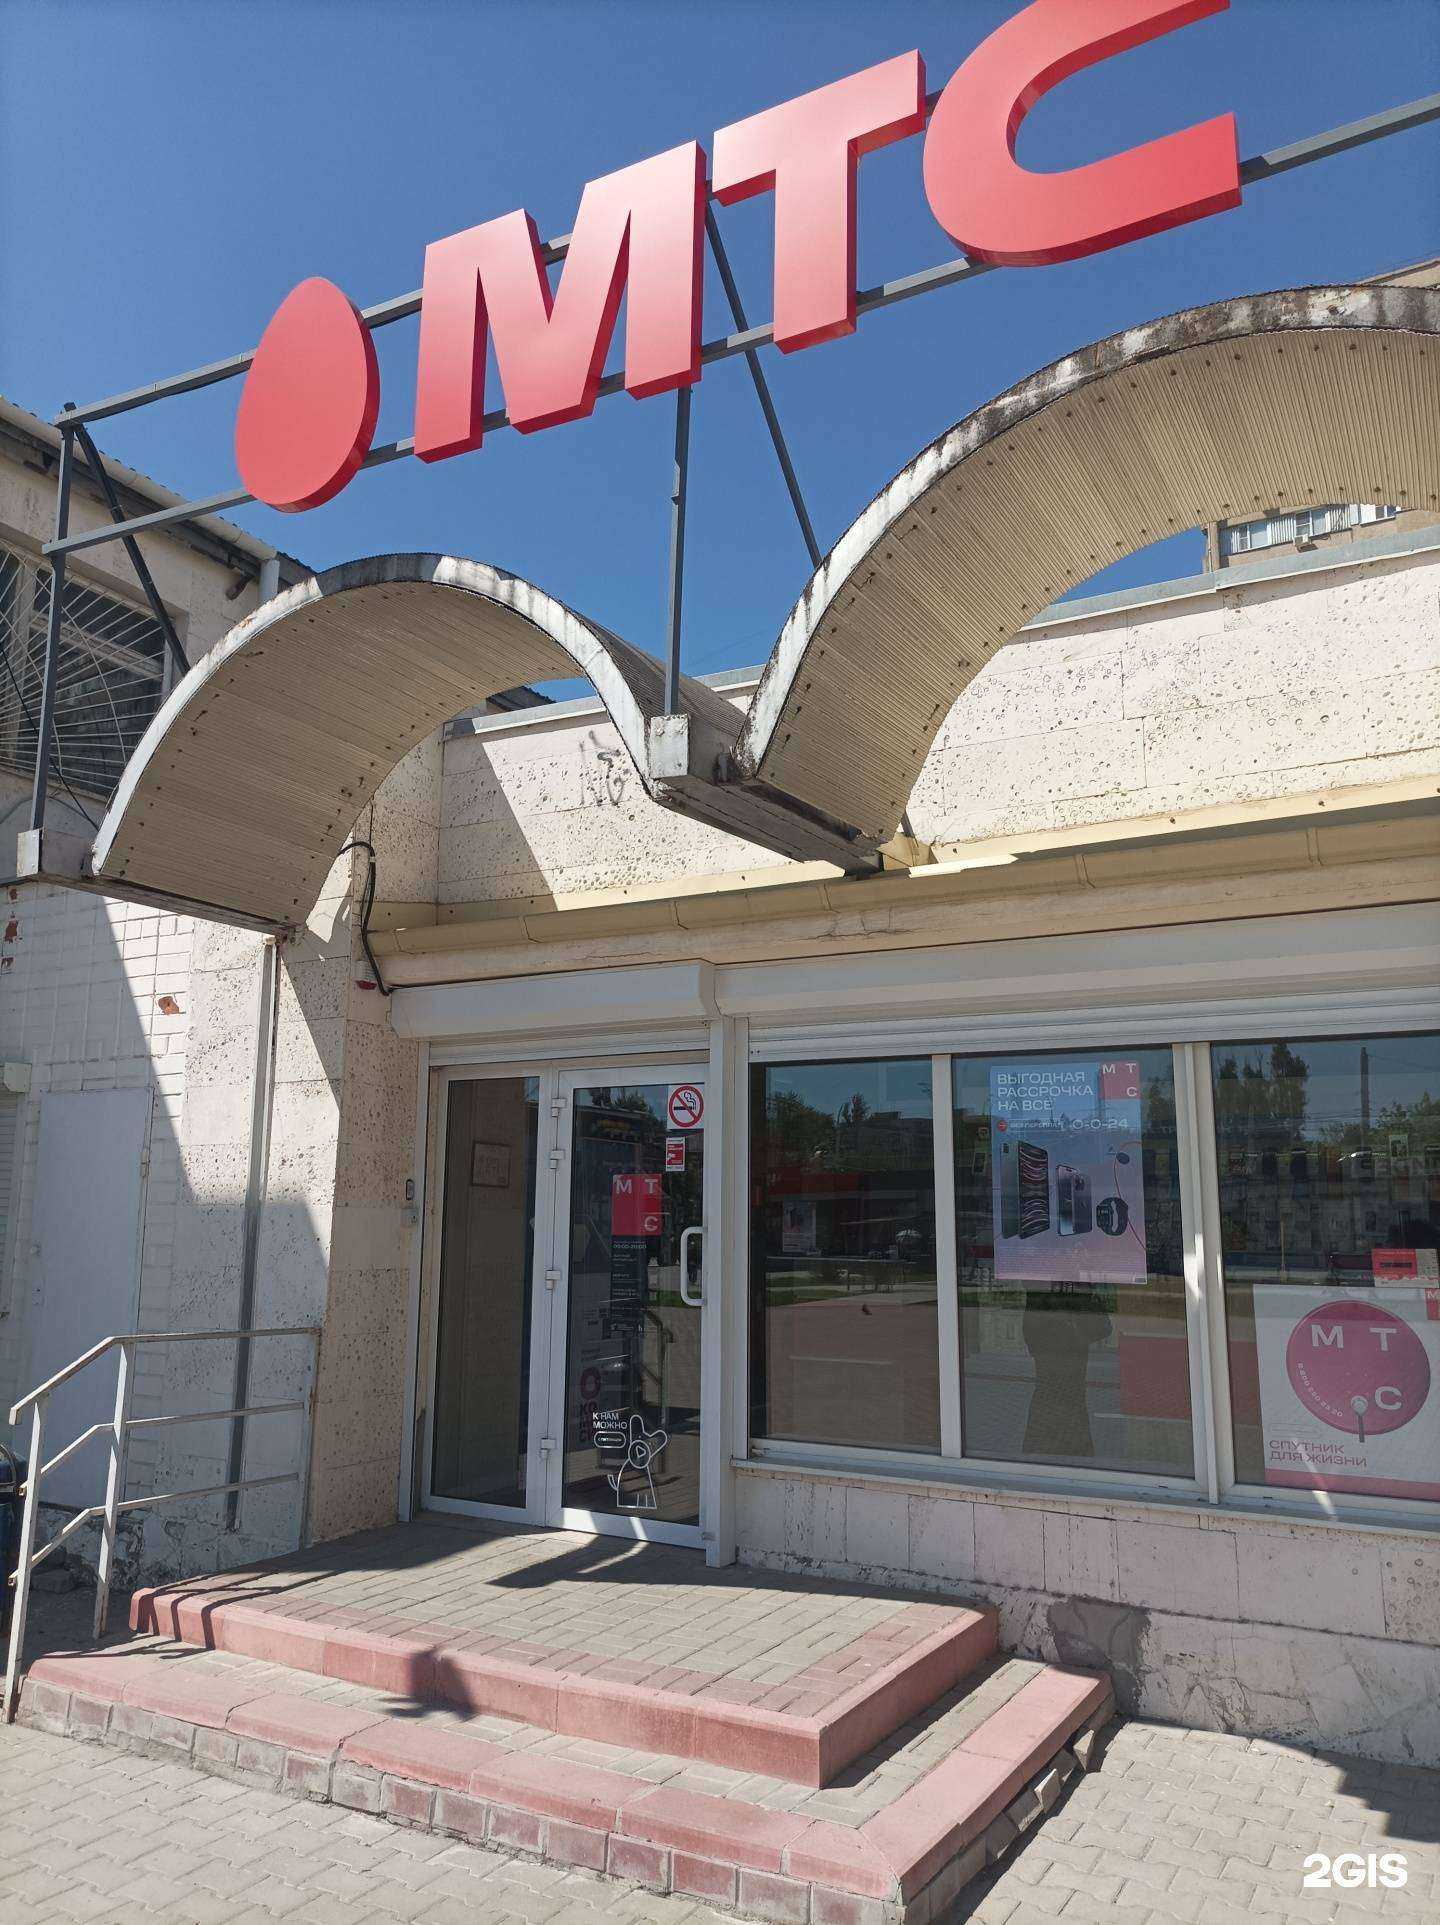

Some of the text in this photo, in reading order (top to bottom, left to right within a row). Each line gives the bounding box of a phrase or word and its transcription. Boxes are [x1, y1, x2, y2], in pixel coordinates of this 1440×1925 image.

[414, 0, 1242, 463] МТС
[997, 1071, 1086, 1085] ВЫГОДНАЯ
[997, 1085, 1094, 1098] РАССРОЧКА
[997, 1100, 1019, 1111] НА
[1311, 1324, 1397, 1352] М Т
[592, 1411, 599, 1420] К
[592, 1421, 628, 1430] МОЖНО
[1269, 1439, 1345, 1454] СПУТНИК
[1271, 1450, 1368, 1467] ДЛЯ ЖИЗНИ
